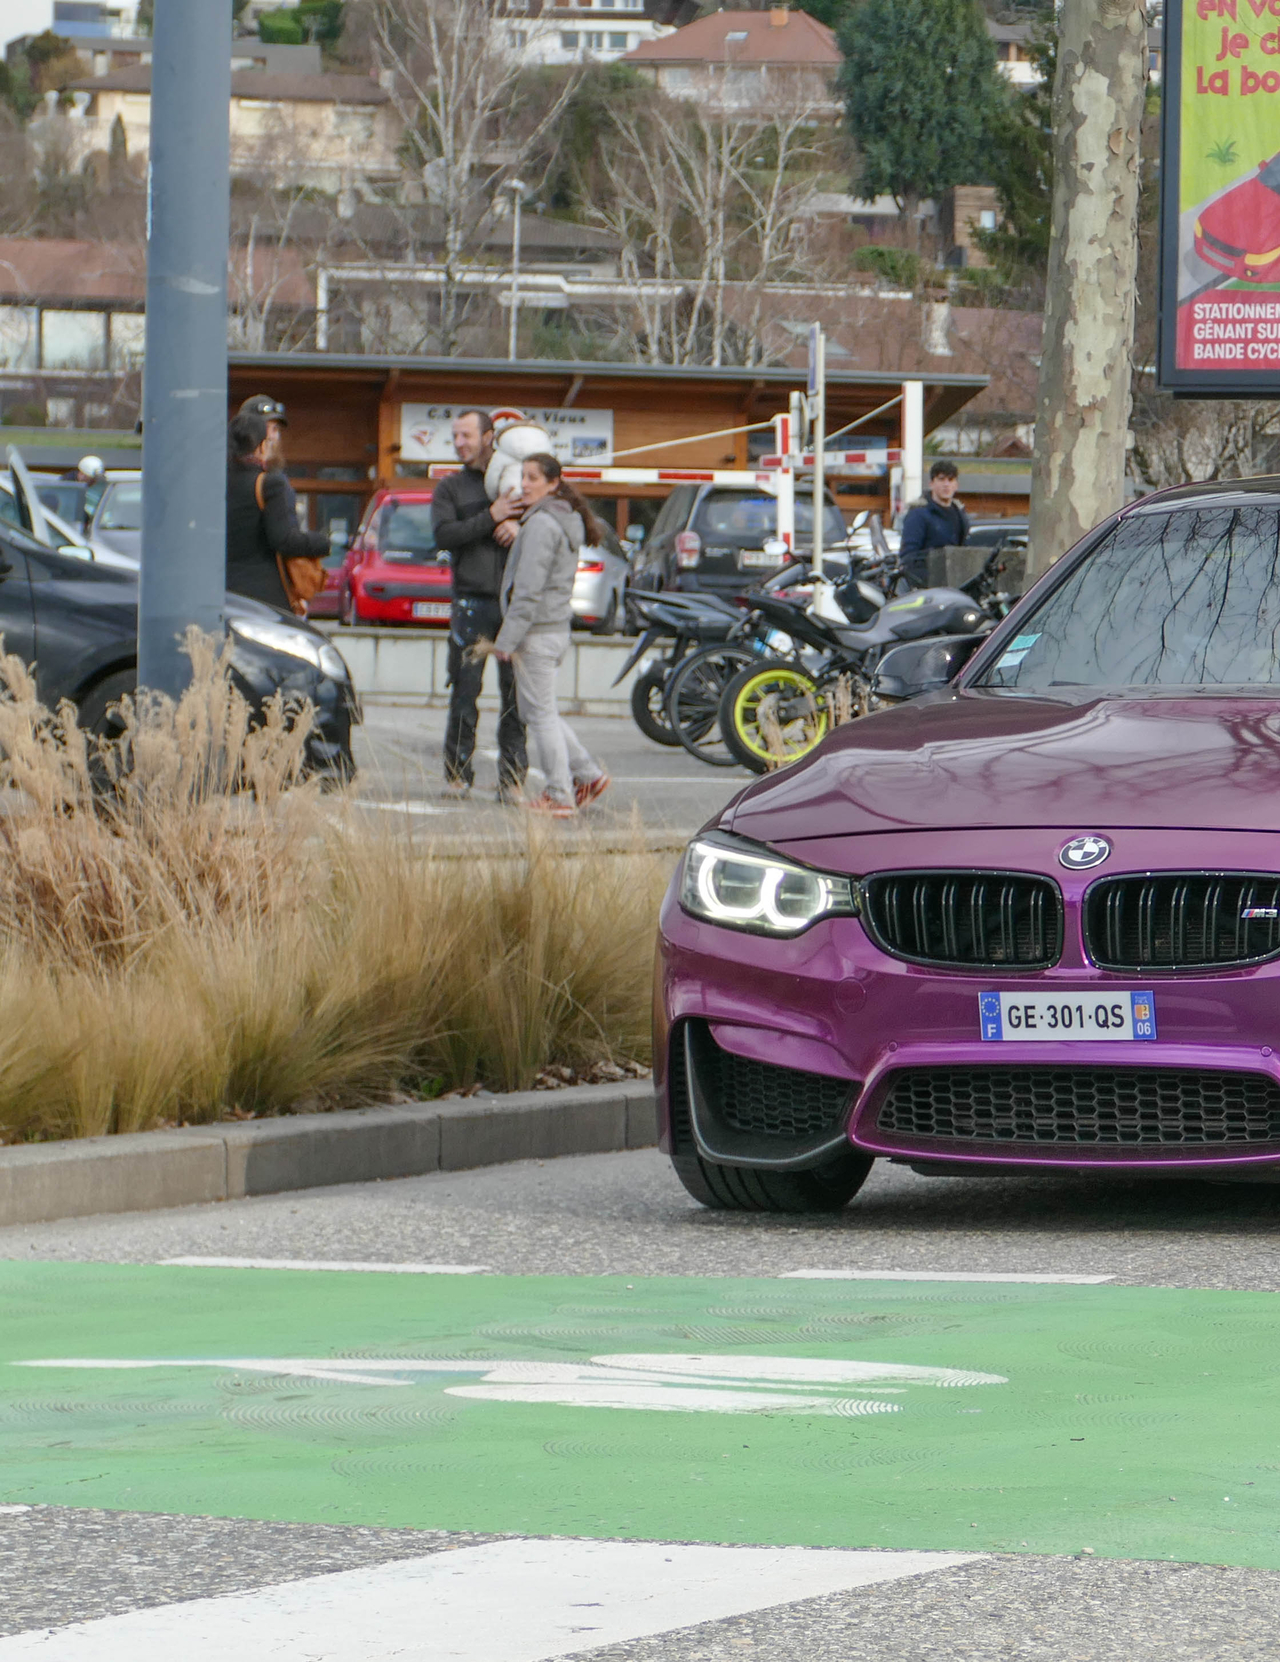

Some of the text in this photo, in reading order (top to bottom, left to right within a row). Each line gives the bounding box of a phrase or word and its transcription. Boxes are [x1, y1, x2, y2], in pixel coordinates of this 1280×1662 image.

[1216, 26, 1249, 61] je
[1193, 320, 1254, 339] GÊNANT
[1193, 343, 1245, 359] BANDE
[1253, 908, 1278, 918] M3
[987, 1024, 997, 1038] F
[1137, 1021, 1151, 1035] 06
